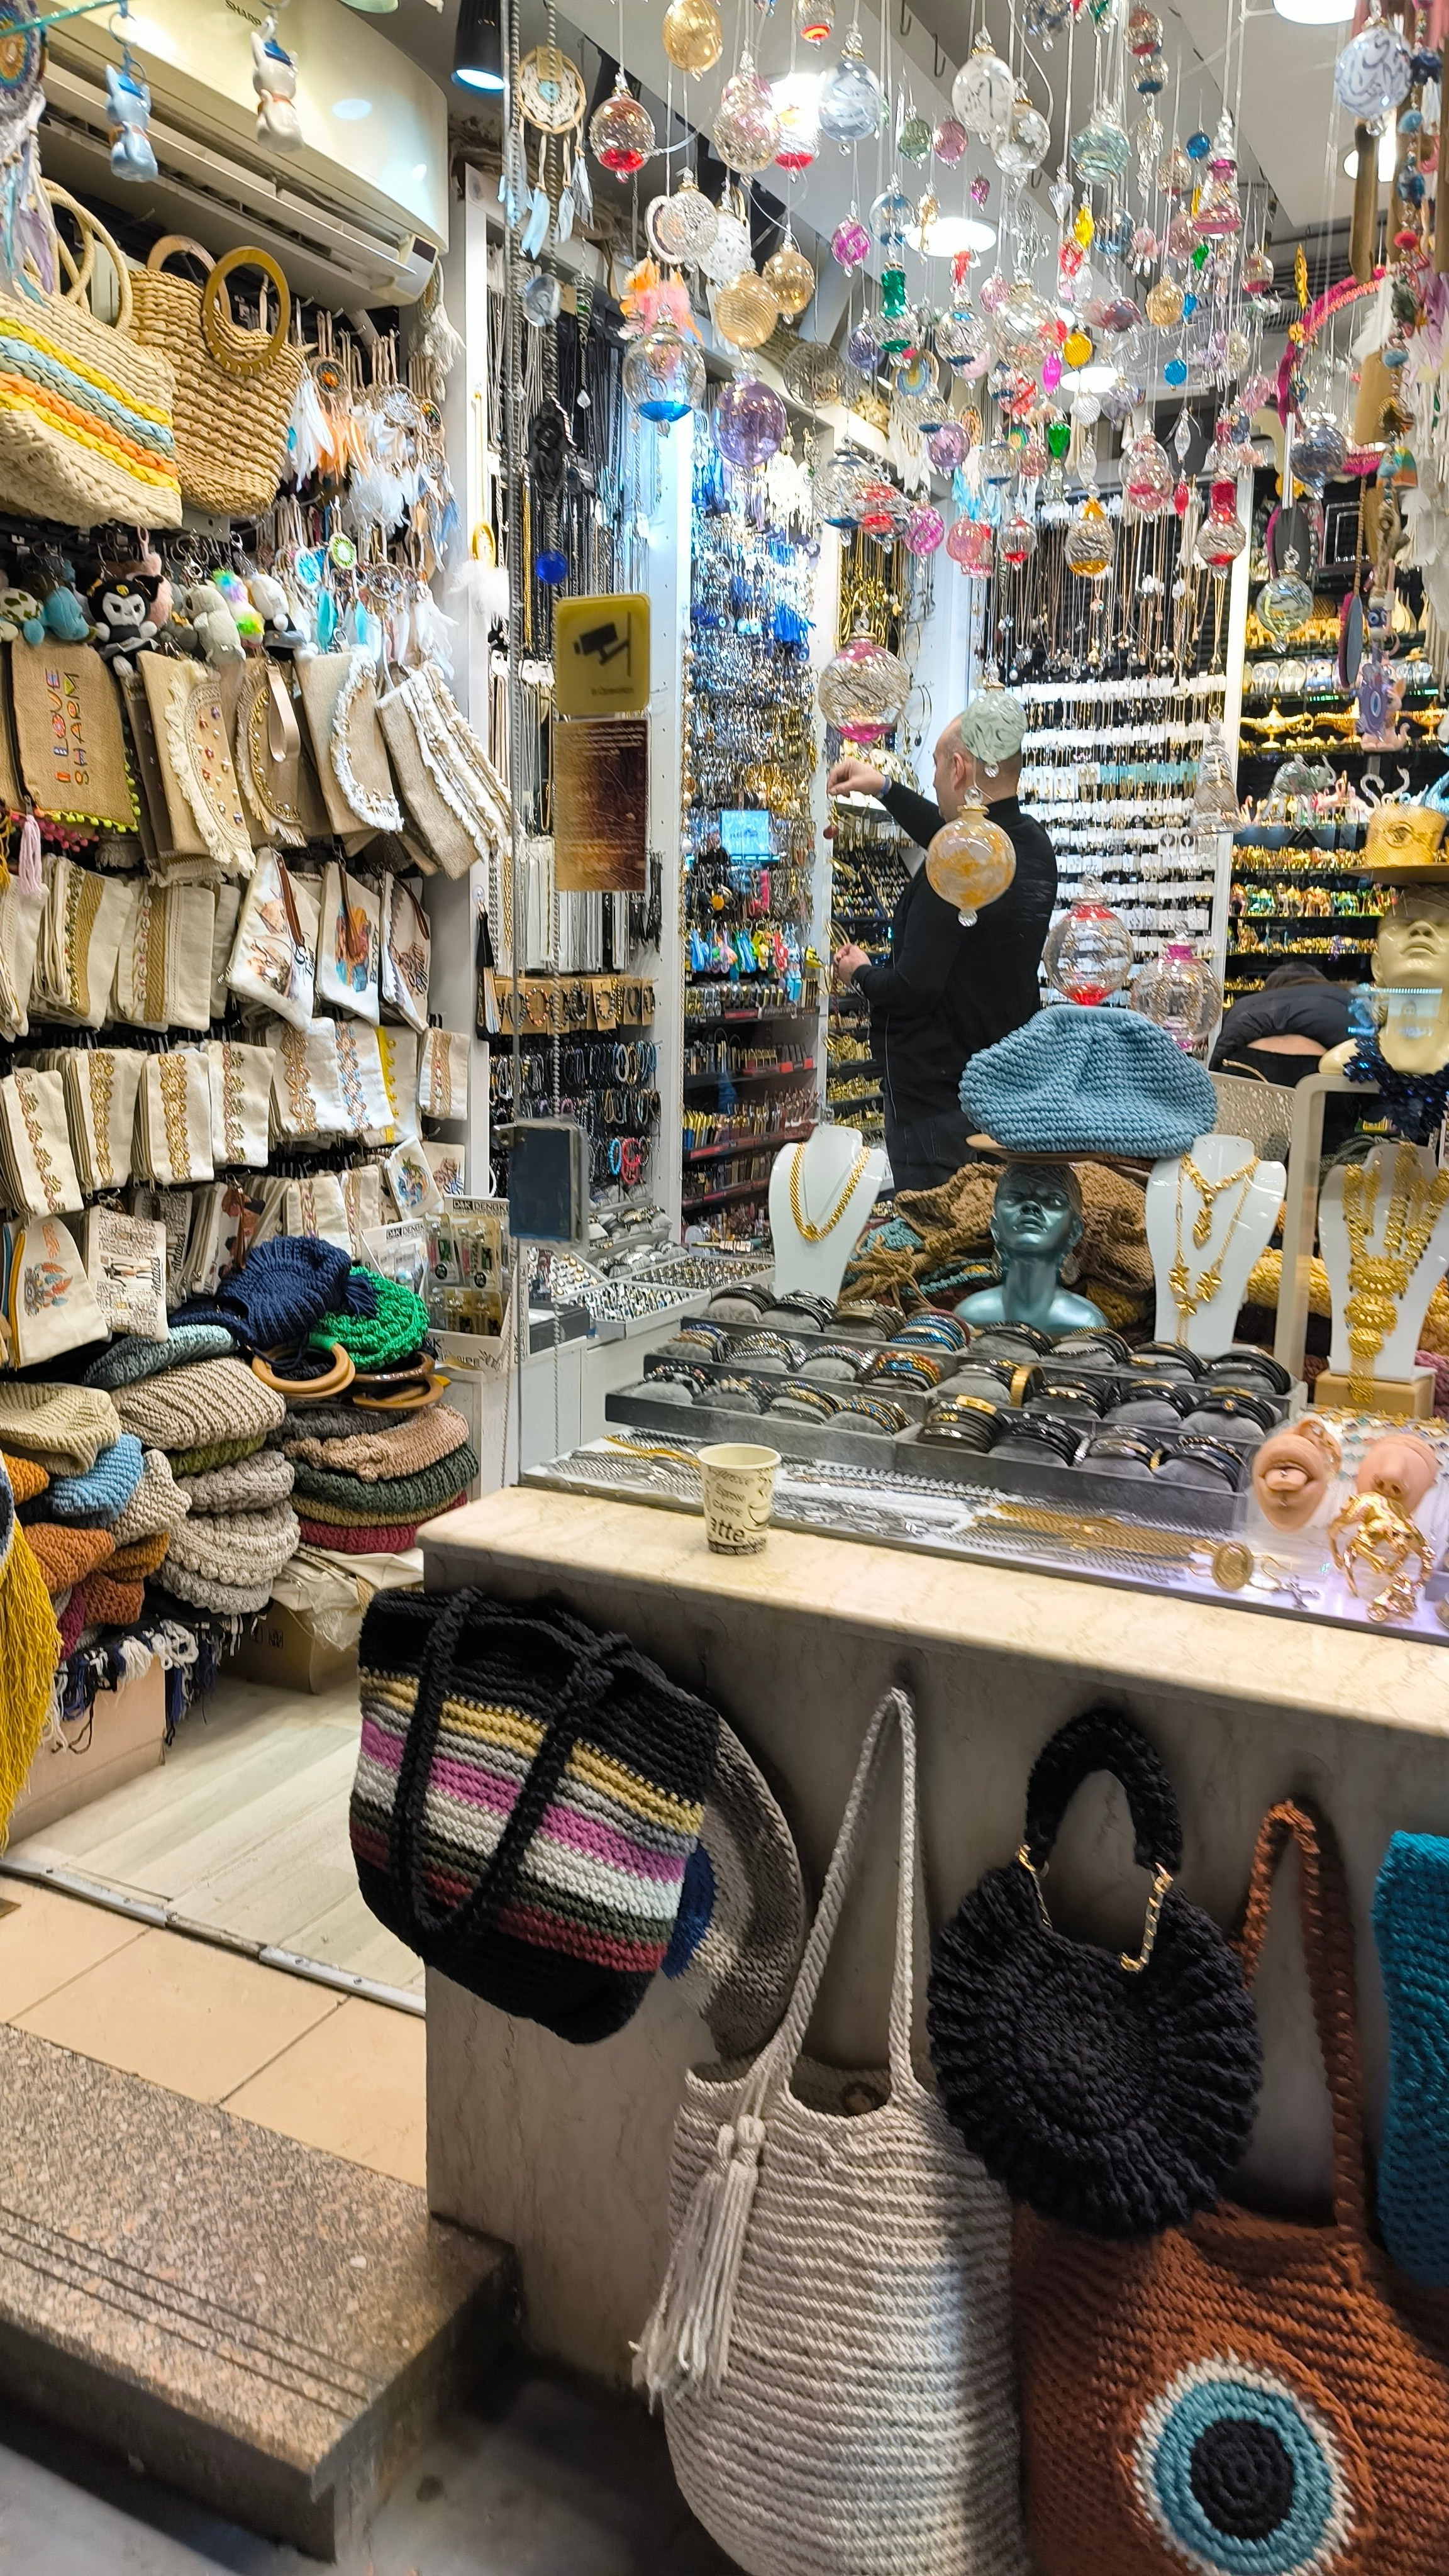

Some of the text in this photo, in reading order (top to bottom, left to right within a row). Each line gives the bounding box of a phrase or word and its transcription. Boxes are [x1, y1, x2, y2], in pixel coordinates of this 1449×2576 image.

[225, 0, 262, 27] SHARP
[45, 667, 71, 784] I LOVE
[64, 671, 89, 786] SHARM
